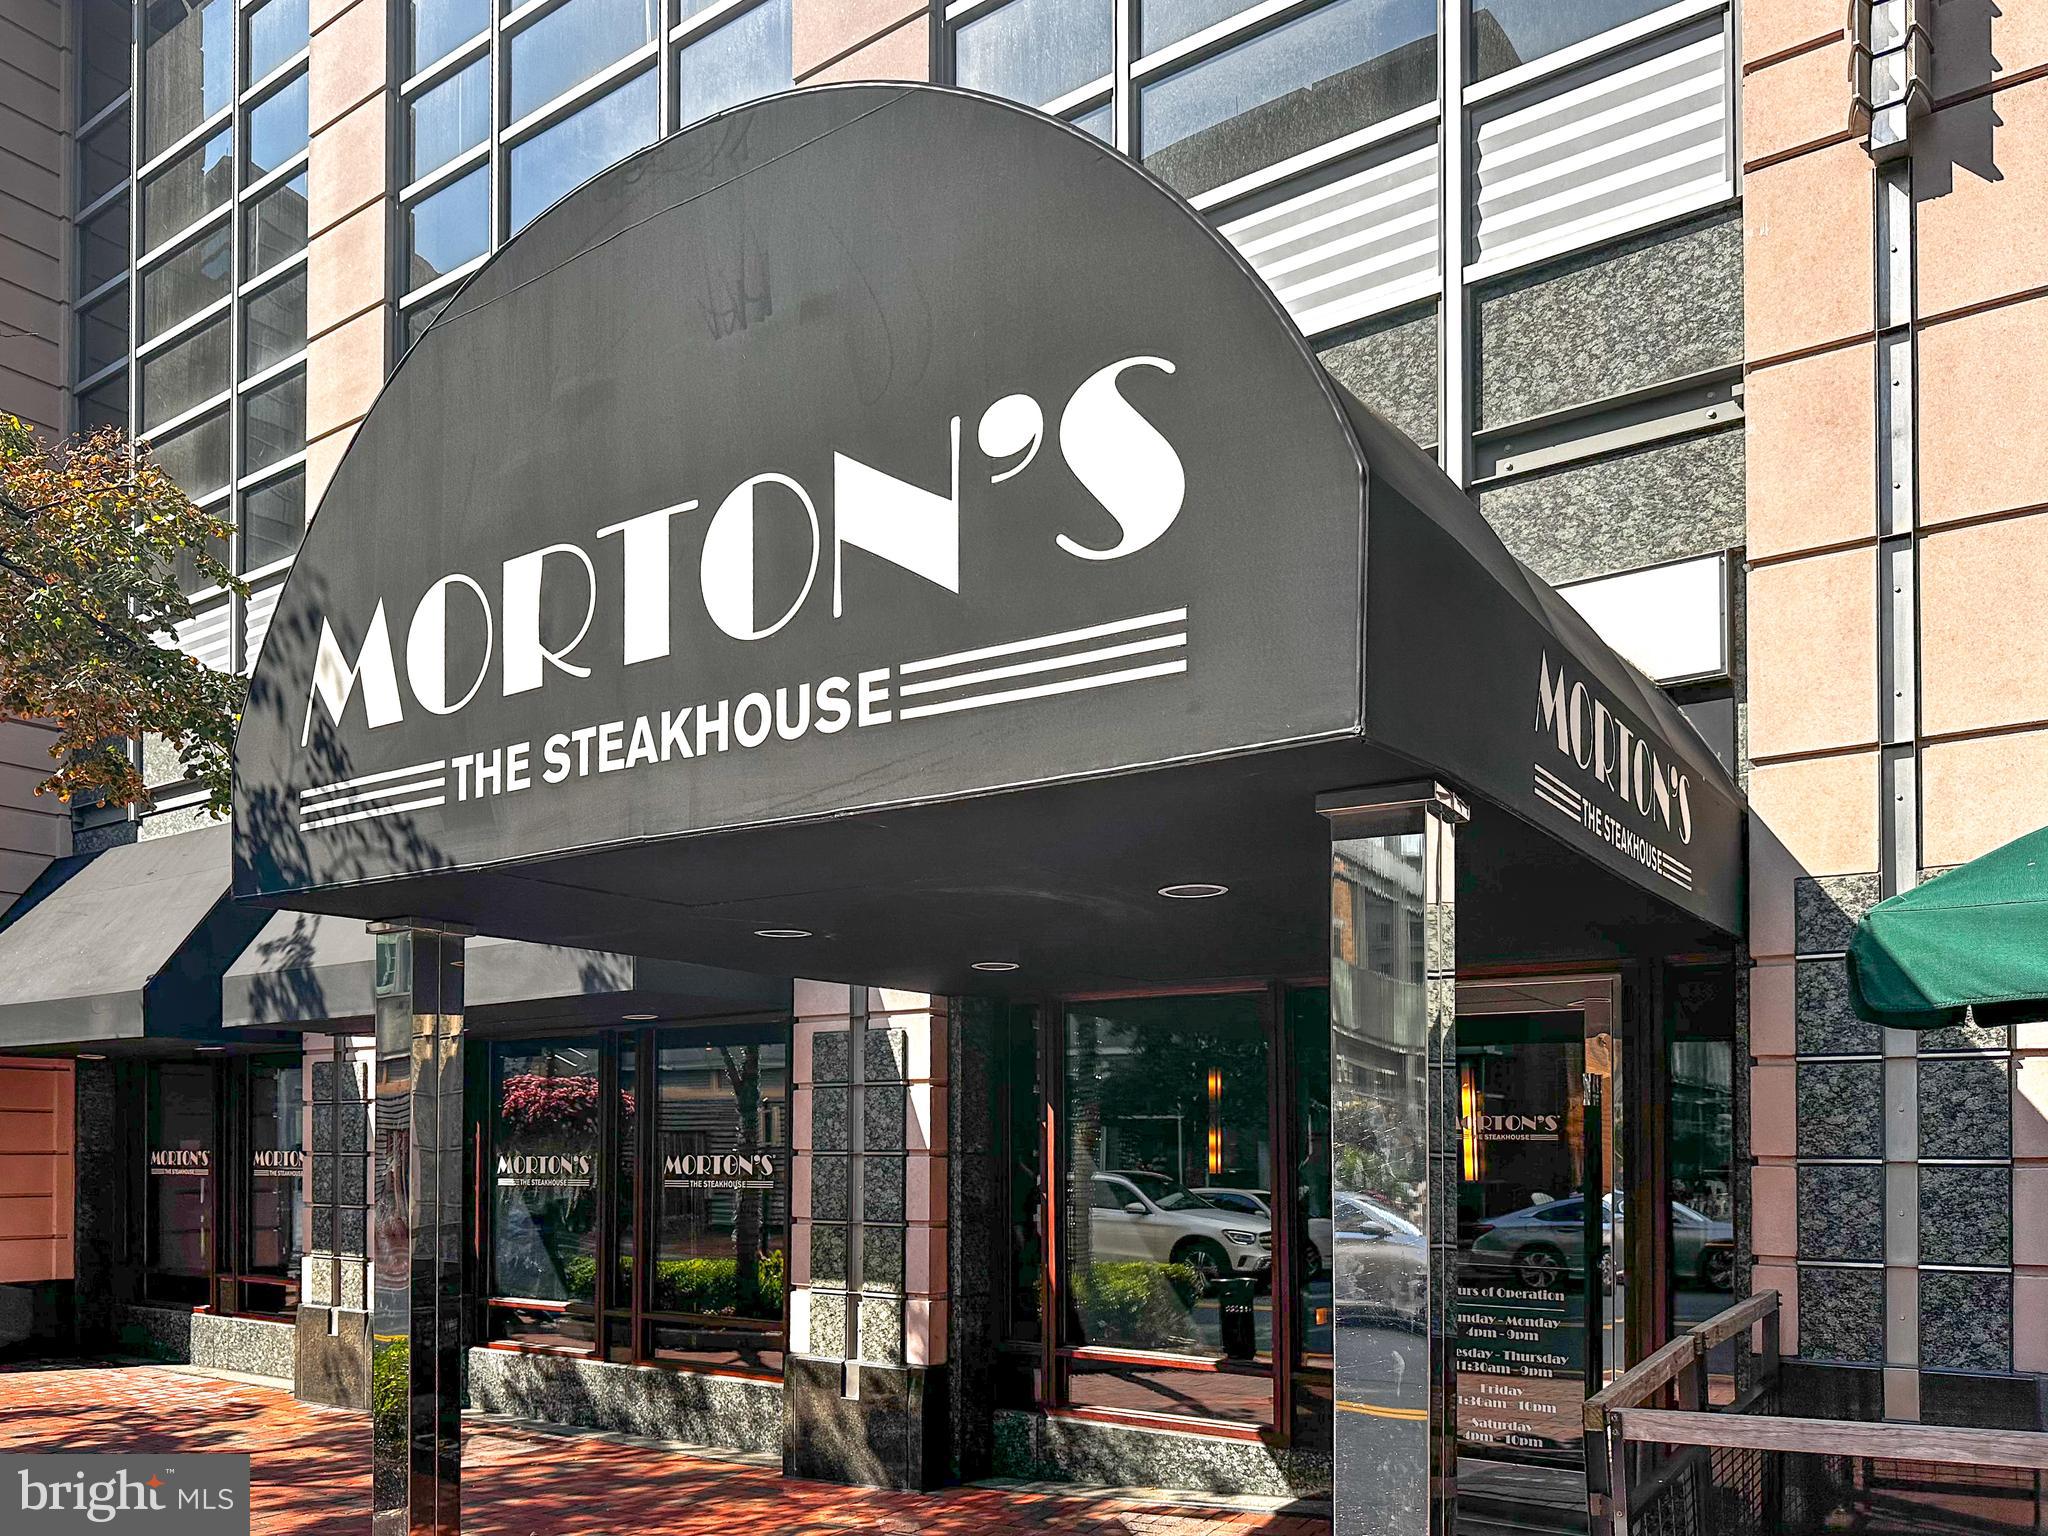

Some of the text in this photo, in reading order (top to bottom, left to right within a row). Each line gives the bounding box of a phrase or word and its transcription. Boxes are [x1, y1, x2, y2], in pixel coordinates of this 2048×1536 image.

[302, 354, 1186, 748] MORTON'S
[452, 667, 892, 802] THE STEAKHOUSE
[1534, 649, 1692, 845] MORTON'S
[1582, 797, 1663, 875] THE STEAKHOUSE
[1456, 1114, 1559, 1131] ORTON'S
[151, 1150, 209, 1166] MORTON'S
[253, 1150, 303, 1167] MORTON
[497, 1155, 591, 1175] MORTON'S
[663, 1154, 774, 1176] MORTON'S
[520, 1178, 567, 1187] THE STEAKHOUSE
[690, 1180, 746, 1189] THE STEAKHOUSE
[1457, 1286, 1565, 1301] urs of Operation
[1505, 1316, 1561, 1329] Monday
[1466, 1326, 1498, 1338] 4pm
[1507, 1329, 1540, 1341] 9pm
[1456, 1348, 1494, 1359] esday
[1502, 1350, 1569, 1365] Thursday
[1520, 1365, 1553, 1378] 9pm
[1480, 1383, 1525, 1396] Friday
[1458, 1395, 1507, 1409] 1:30am
[1519, 1400, 1557, 1414] 10pm
[1471, 1417, 1533, 1432] Saturday
[1463, 1430, 1494, 1443] 4pm
[1505, 1434, 1543, 1448] 10pm
